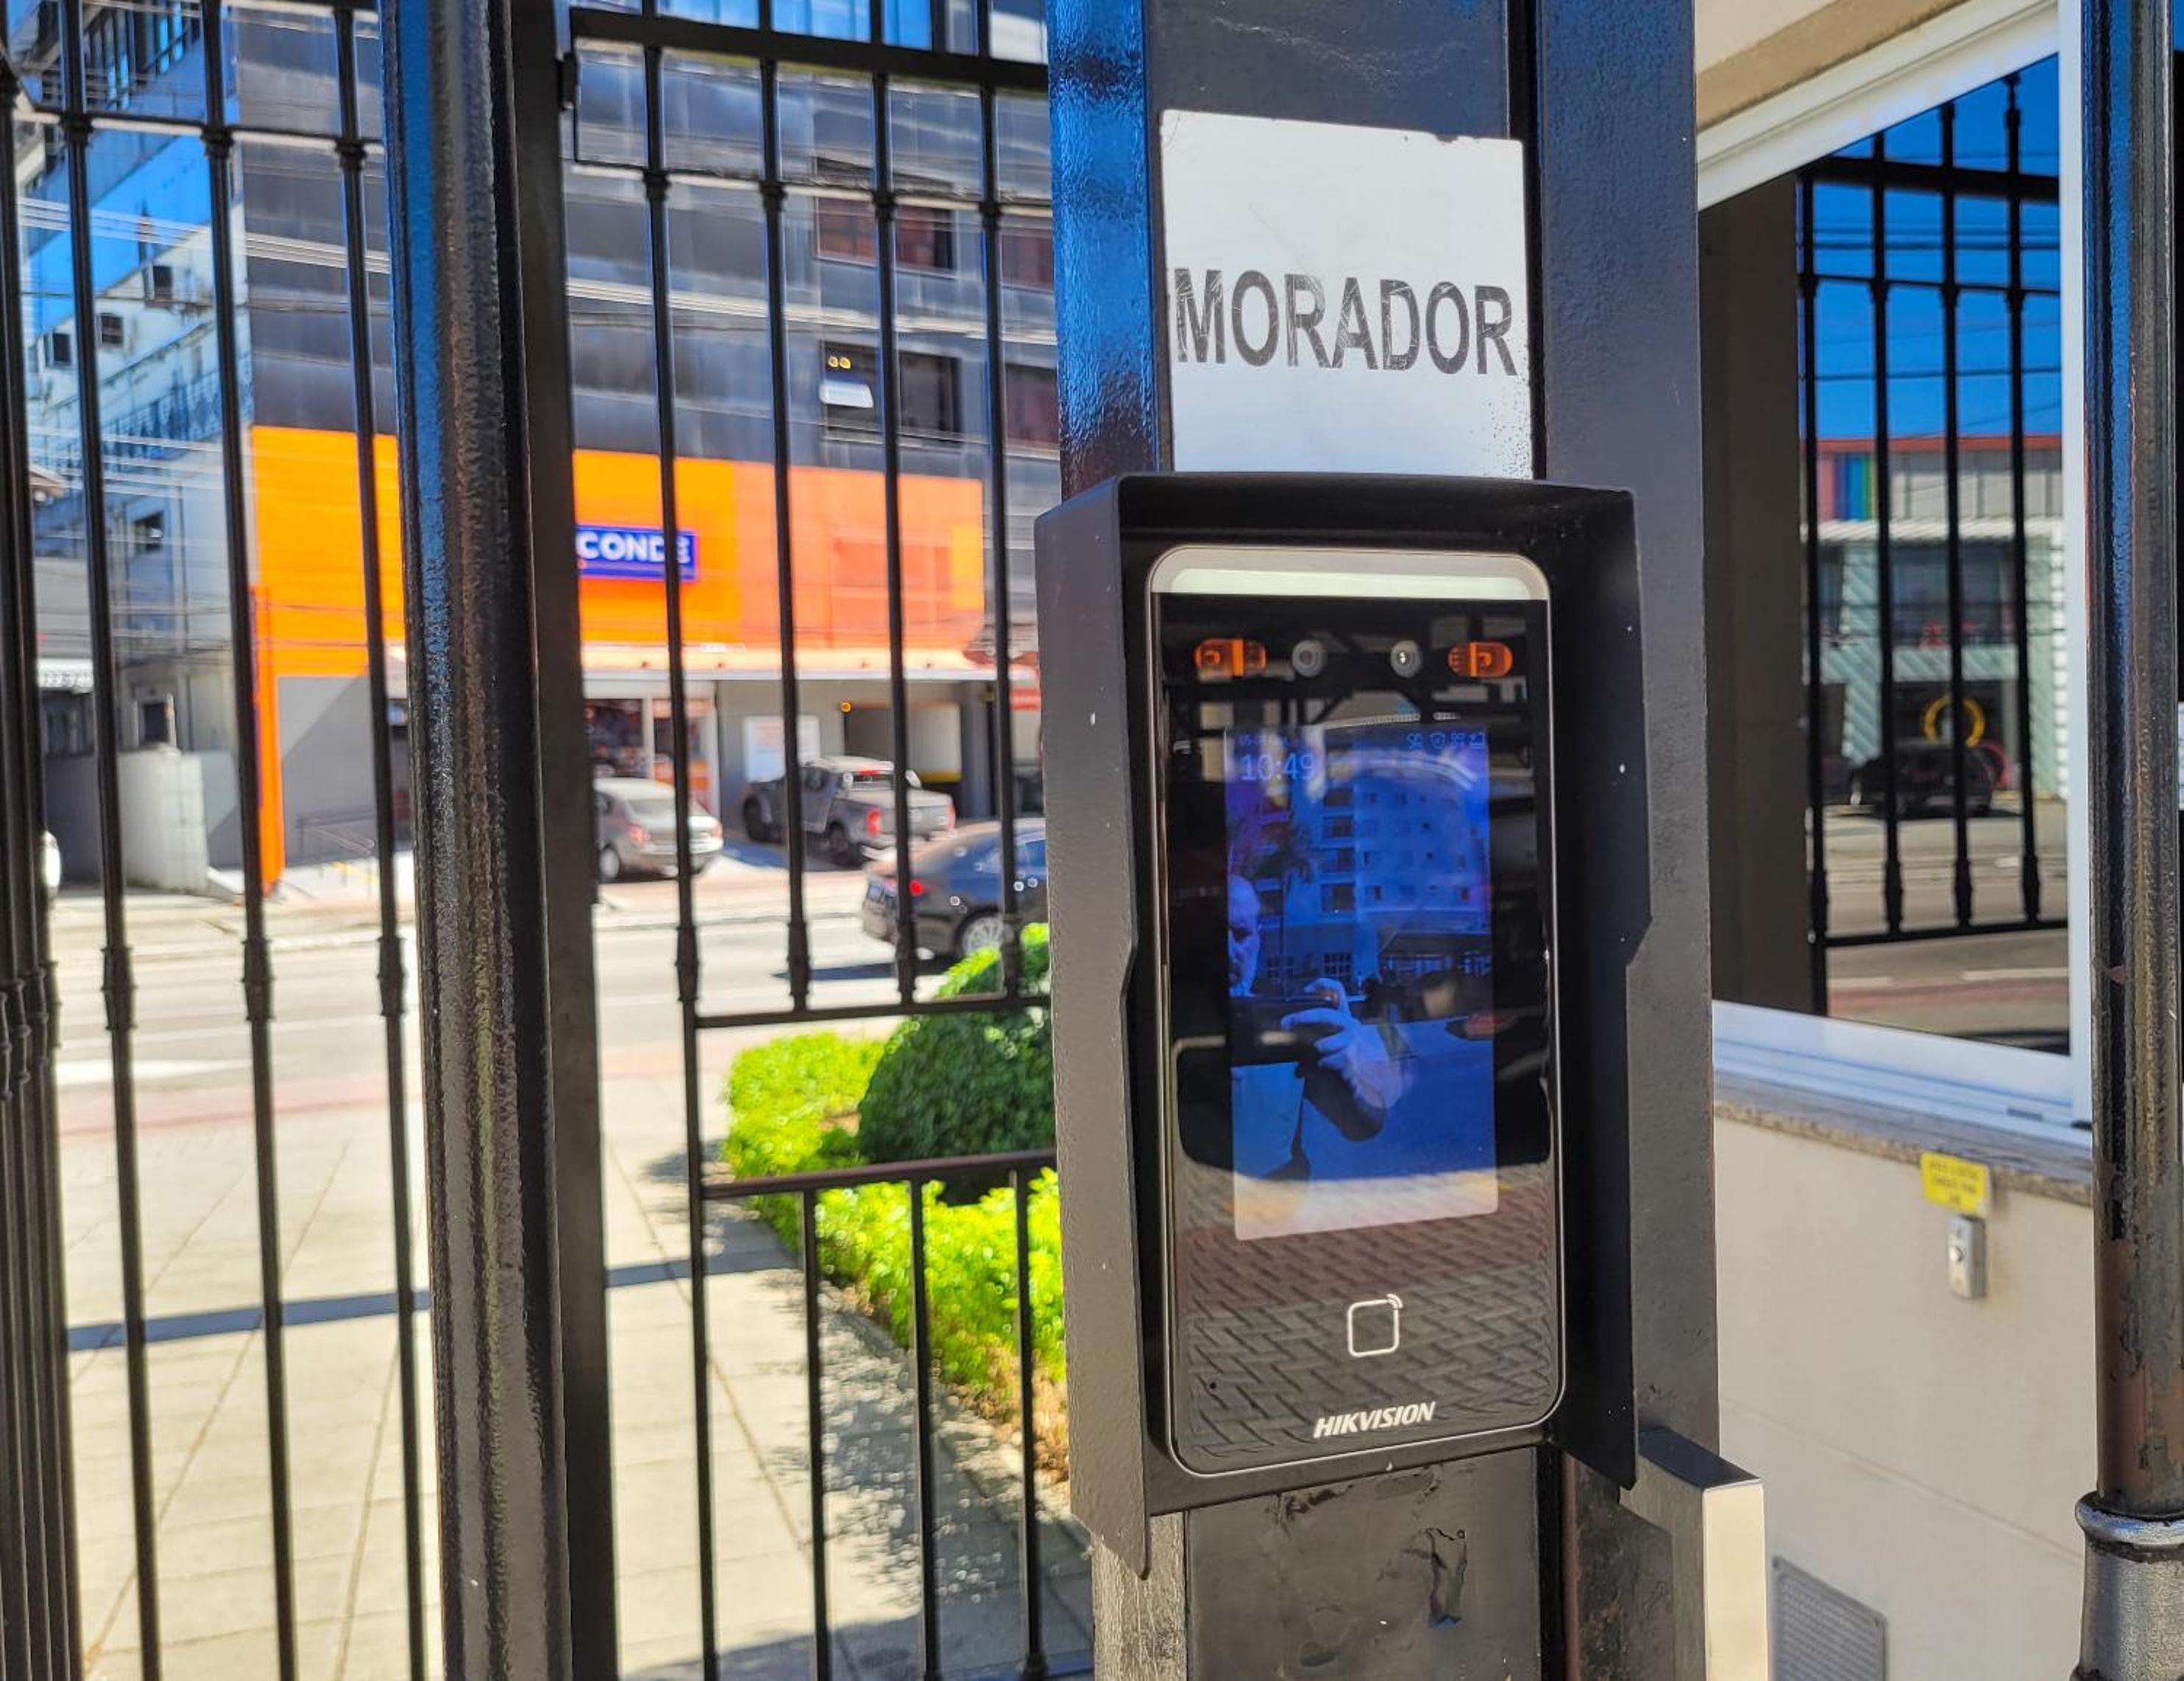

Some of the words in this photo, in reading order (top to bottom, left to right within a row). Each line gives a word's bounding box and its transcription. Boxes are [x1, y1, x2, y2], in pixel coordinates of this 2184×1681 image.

[1174, 268, 1517, 375] MORADOR
[1241, 753, 1314, 781] 10:49
[1313, 1401, 1436, 1438] HIKVISION
